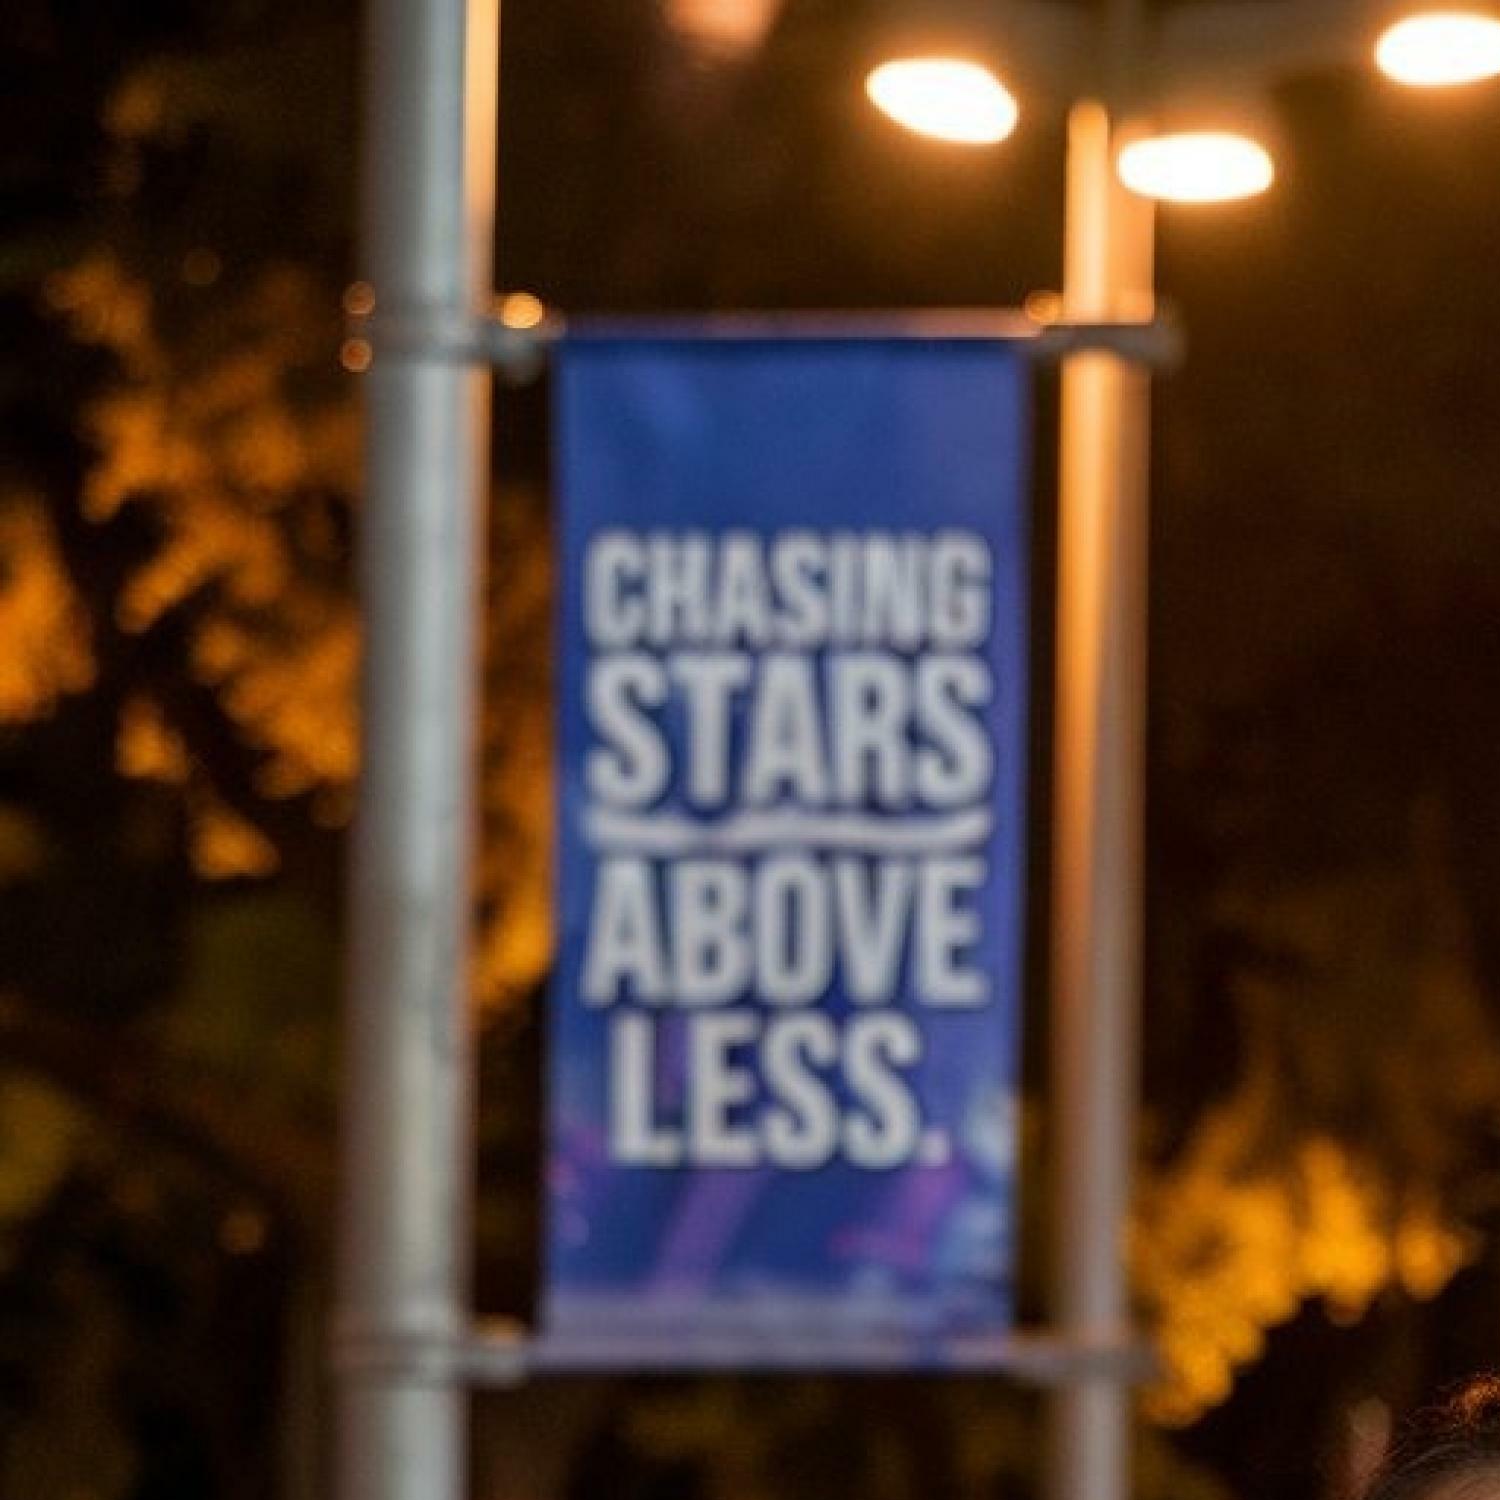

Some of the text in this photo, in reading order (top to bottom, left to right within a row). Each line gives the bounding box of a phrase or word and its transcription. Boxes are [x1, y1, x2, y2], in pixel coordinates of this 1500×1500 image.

[588, 533, 989, 647] CHASING
[588, 652, 992, 805] STARS
[586, 856, 987, 1011] ABOVE
[609, 1015, 952, 1167] LESS.
